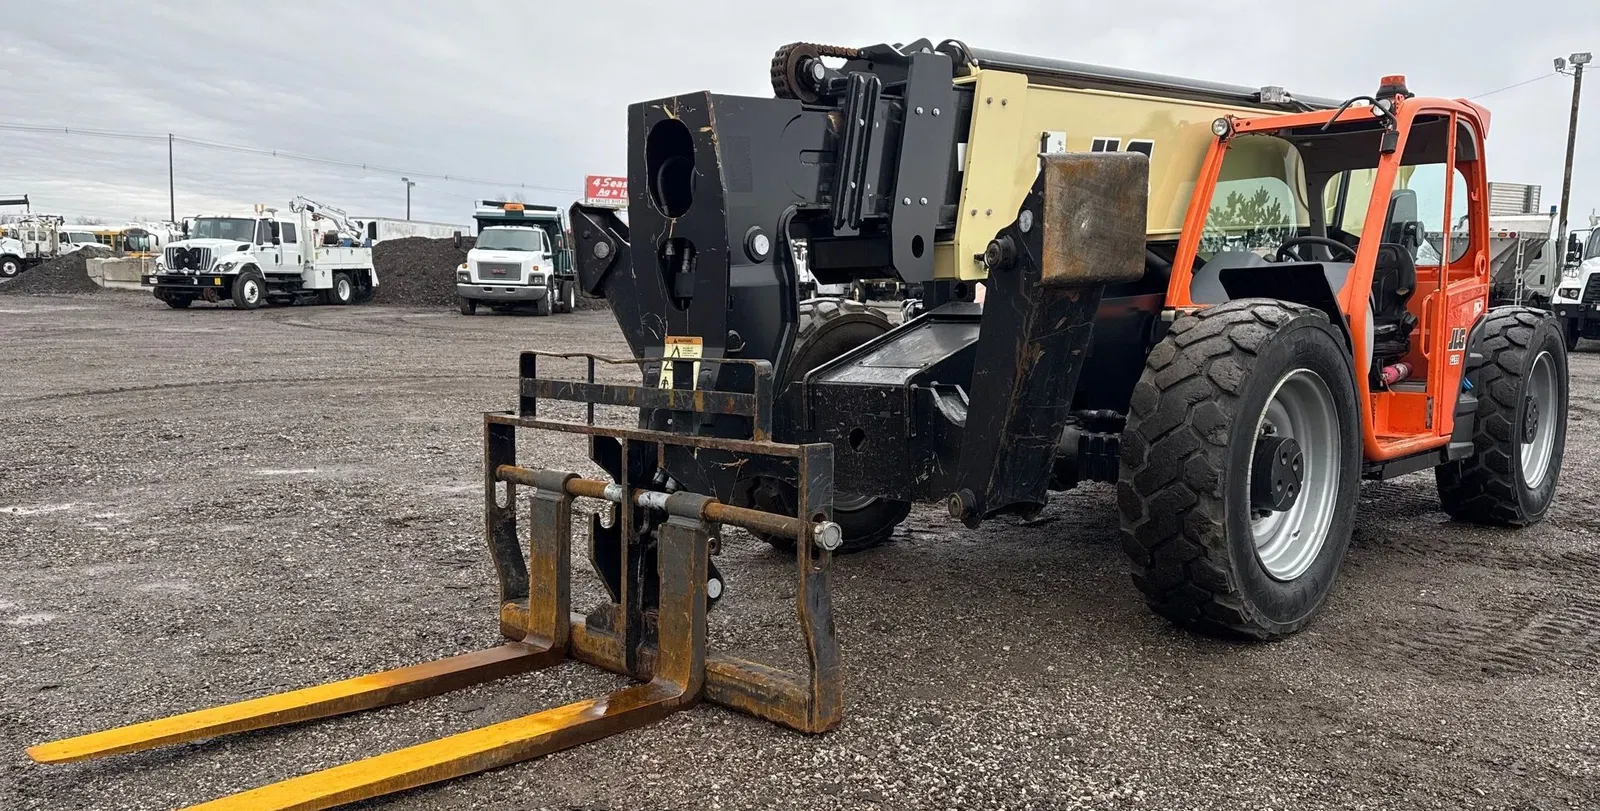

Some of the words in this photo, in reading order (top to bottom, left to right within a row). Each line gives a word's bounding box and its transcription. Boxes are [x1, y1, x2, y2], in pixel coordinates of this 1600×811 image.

[592, 178, 601, 187] 4
[595, 188, 610, 197] Ag
[1448, 328, 1467, 351] JLG
